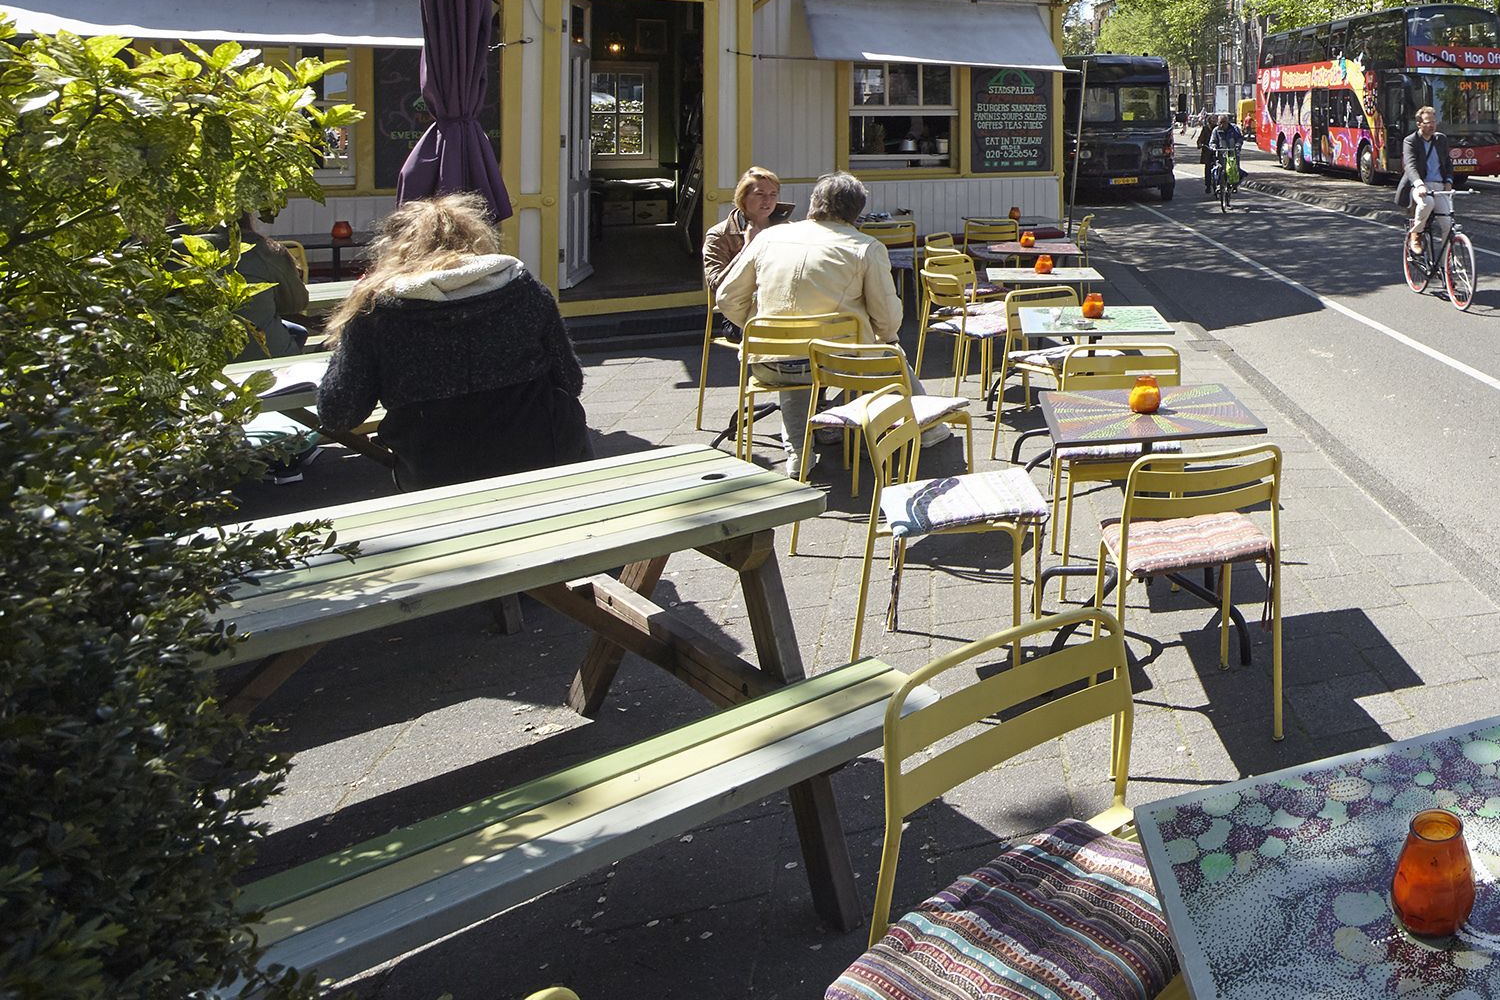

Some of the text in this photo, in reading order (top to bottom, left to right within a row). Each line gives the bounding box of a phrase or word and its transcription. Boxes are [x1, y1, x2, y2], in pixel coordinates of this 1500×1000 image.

[1416, 50, 1437, 63] Hop
[1441, 50, 1456, 62] On
[1465, 52, 1484, 64] Hop
[988, 86, 1035, 95] STADSPALEIS
[1459, 82, 1472, 90] ON
[977, 104, 1047, 112] BURGERS SANDWICHES
[974, 112, 1047, 121] PANINIS SOUPS SALADS
[977, 121, 1043, 129] COFFEES TEAS JUICES
[985, 136, 1043, 145] EAT IN TAKEAWAY
